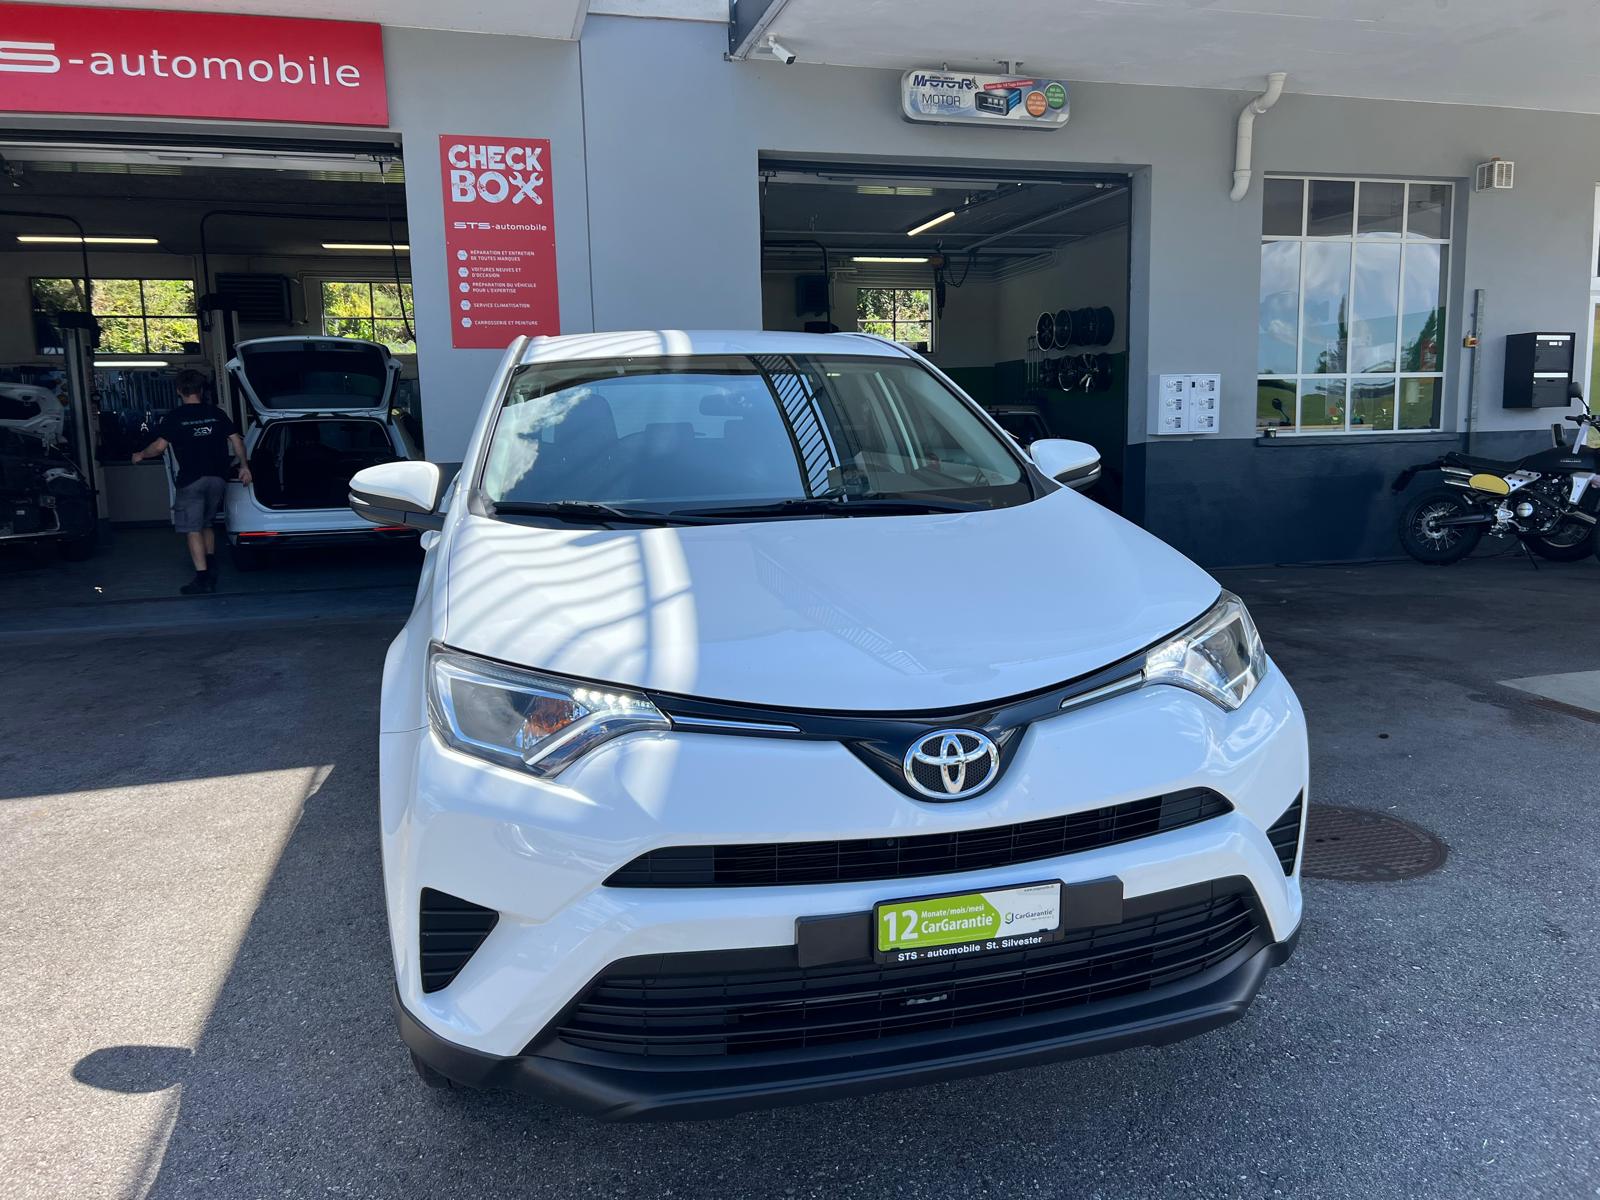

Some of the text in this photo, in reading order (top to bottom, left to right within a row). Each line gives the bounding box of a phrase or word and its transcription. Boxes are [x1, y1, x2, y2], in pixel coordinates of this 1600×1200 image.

[922, 94, 961, 107] MOTOR
[447, 144, 544, 172] CHECK
[450, 169, 544, 205] BOX
[883, 909, 919, 942] 12
[921, 914, 993, 934] CarGarantie
[897, 951, 918, 962] STS
[927, 944, 981, 958] automobile
[985, 941, 999, 950] St.
[1001, 936, 1043, 948] Silvester
